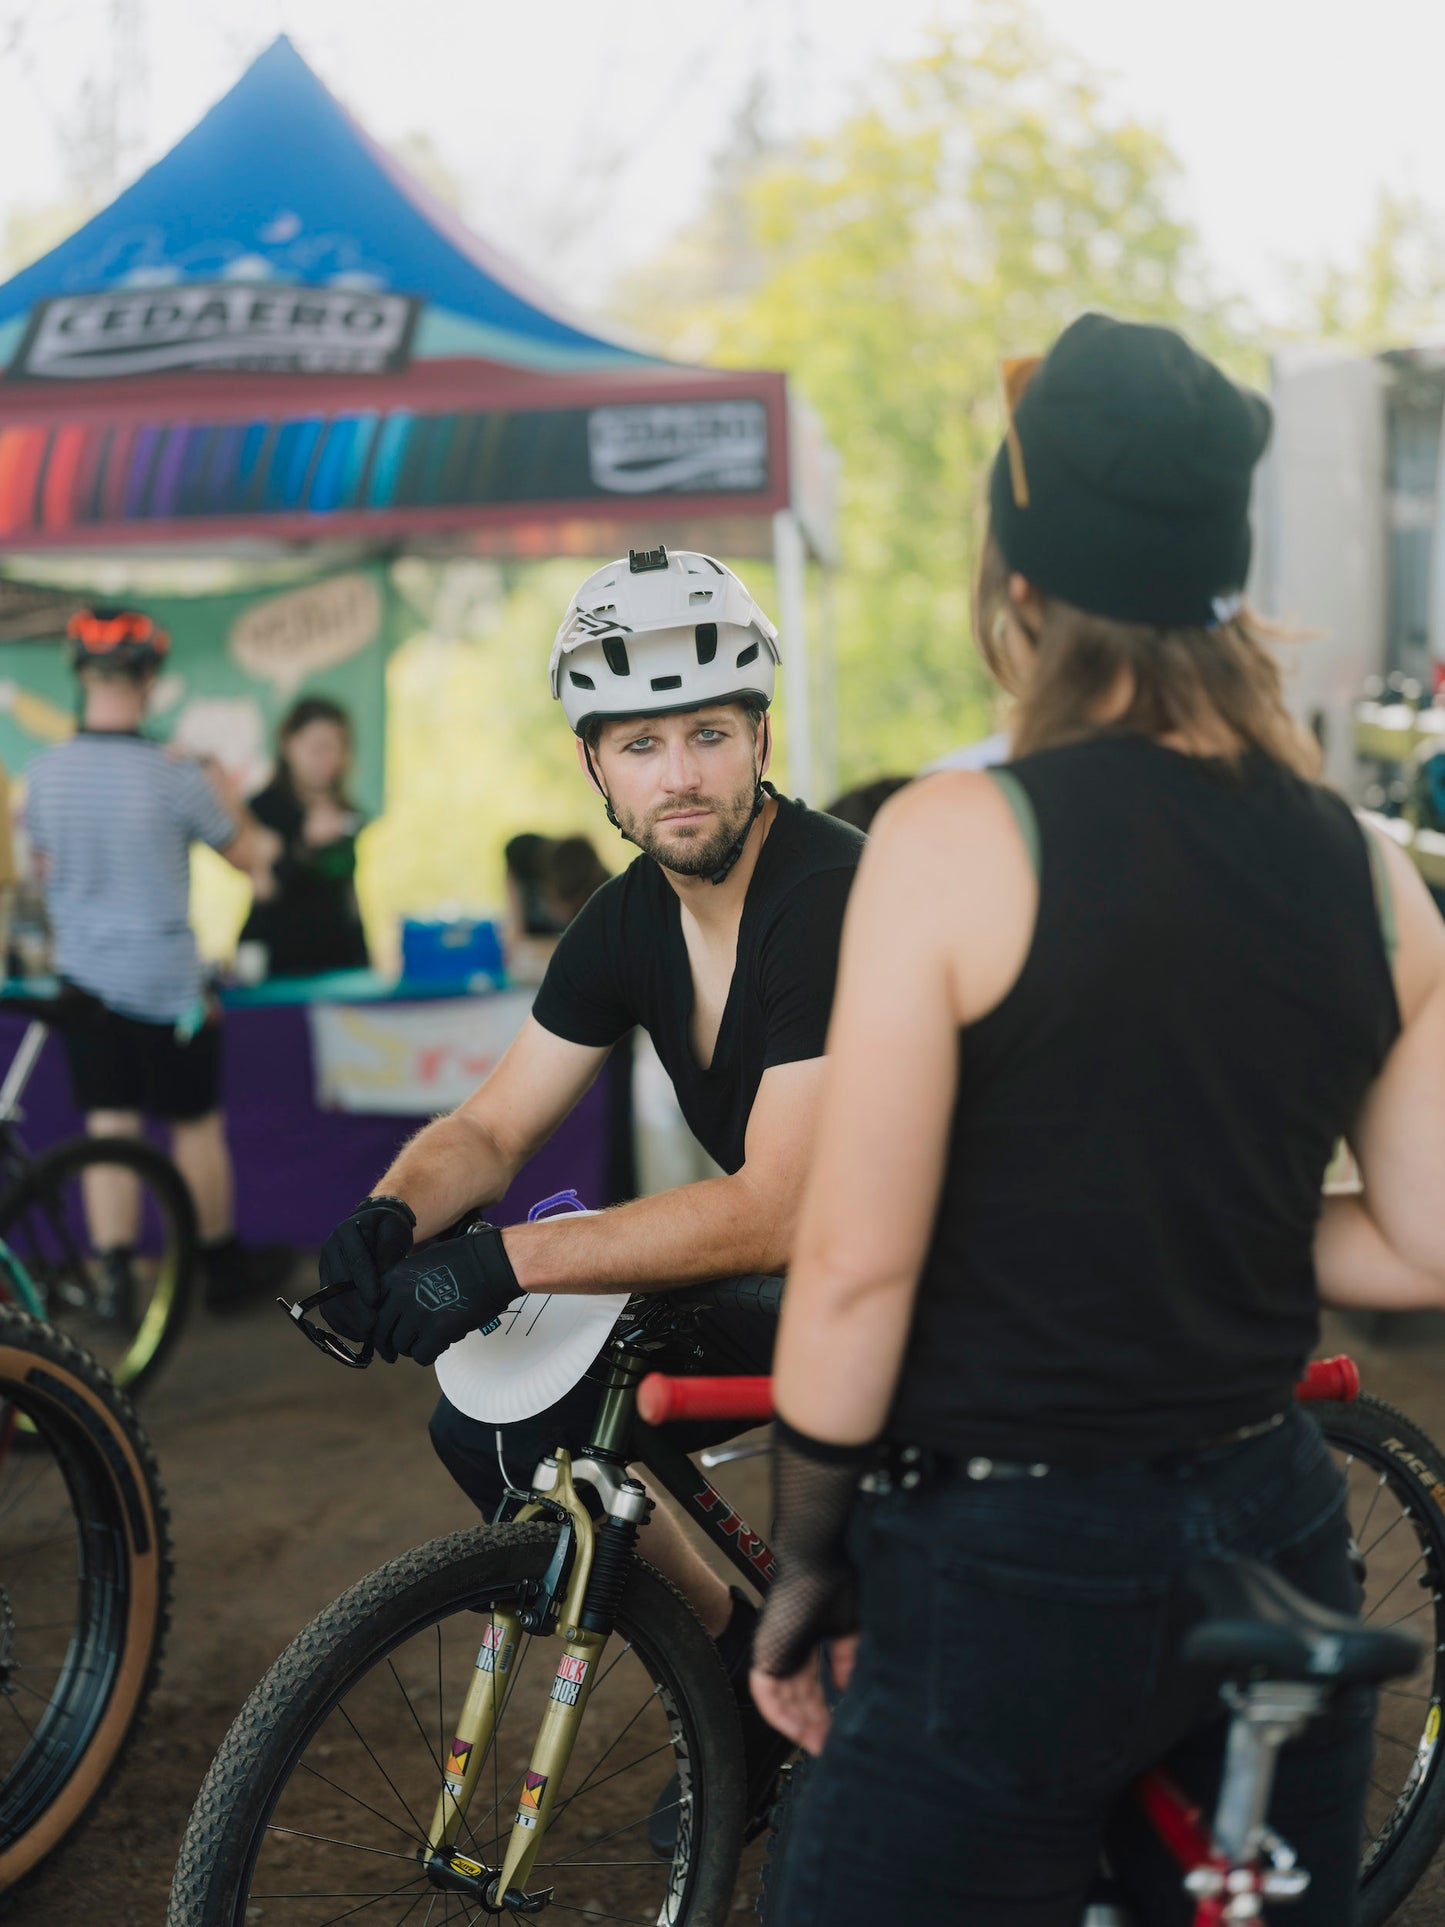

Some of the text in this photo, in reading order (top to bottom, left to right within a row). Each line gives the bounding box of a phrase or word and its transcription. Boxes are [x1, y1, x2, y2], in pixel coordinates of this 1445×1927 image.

[482, 1318, 499, 1334] FIST
[1381, 1438, 1439, 1487] RACE
[550, 1676, 581, 1706] HOX
